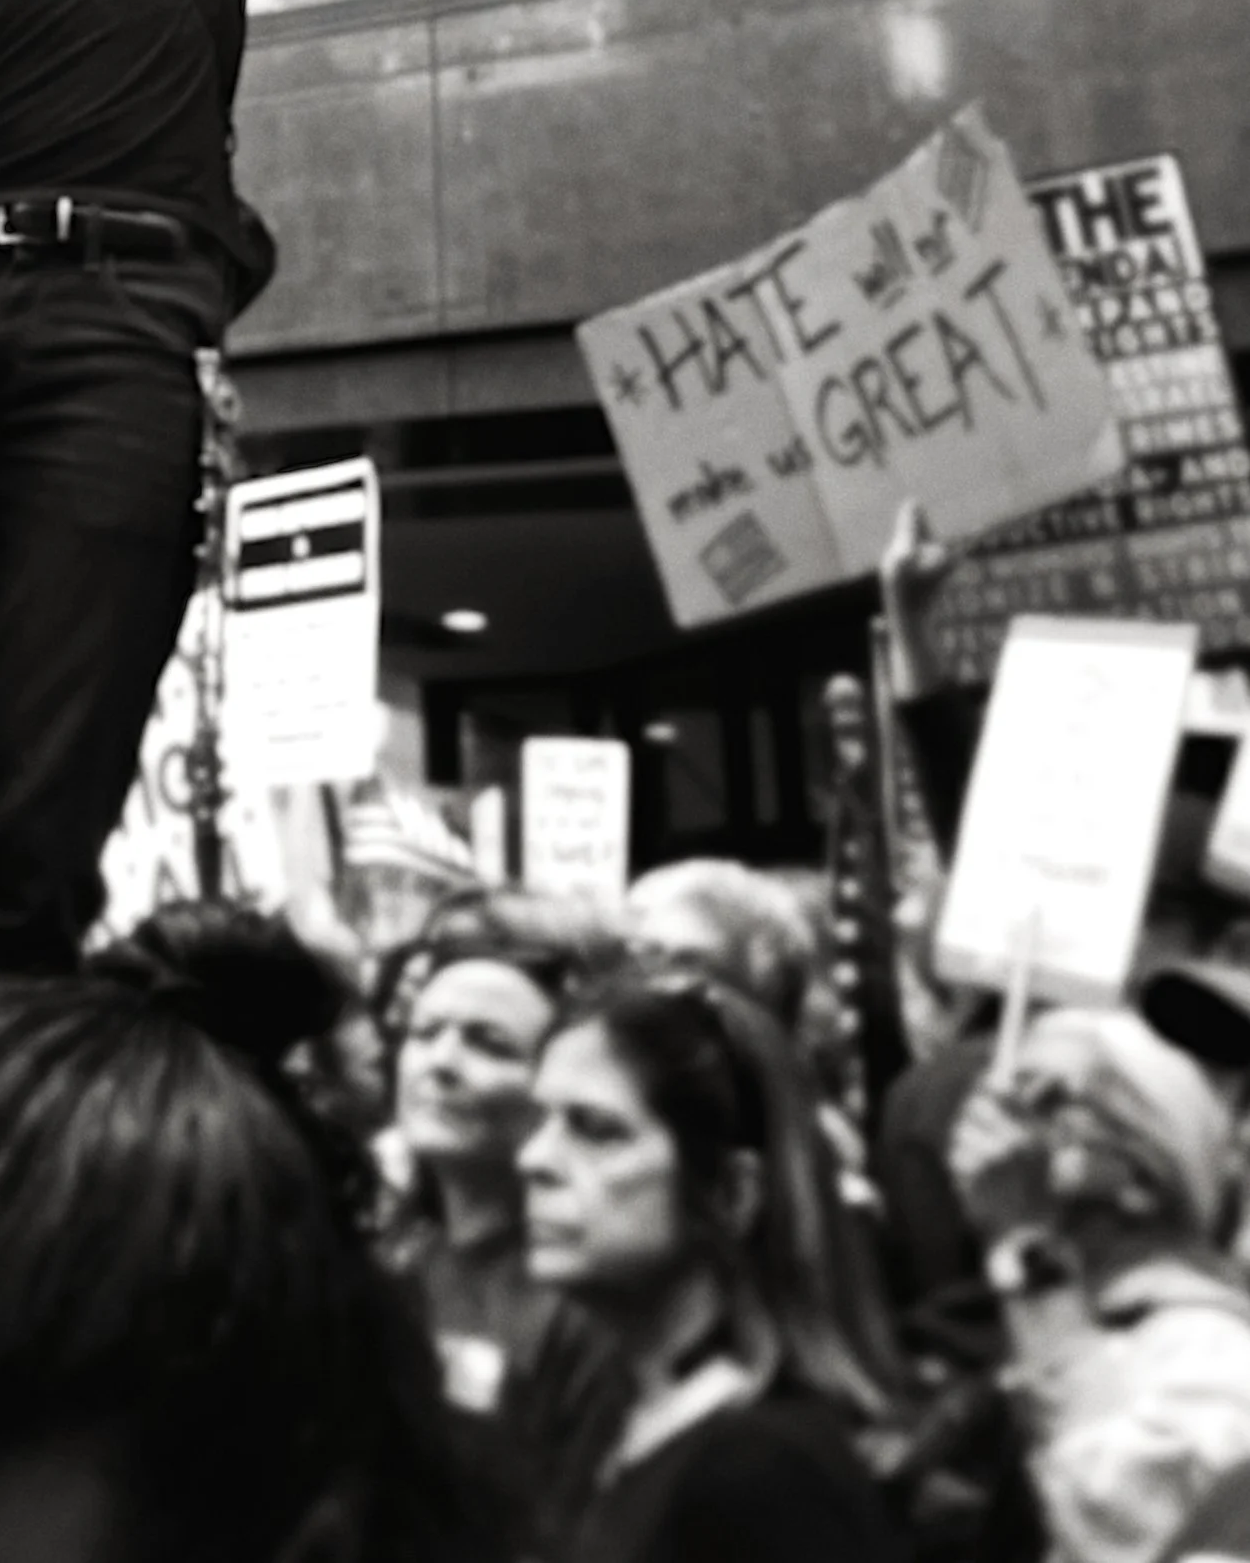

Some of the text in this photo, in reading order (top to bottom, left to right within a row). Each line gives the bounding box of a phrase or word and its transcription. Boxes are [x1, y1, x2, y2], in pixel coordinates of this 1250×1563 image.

[1028, 166, 1175, 256] THE
[637, 238, 842, 412] HATE
[815, 257, 1048, 470] GREAT
